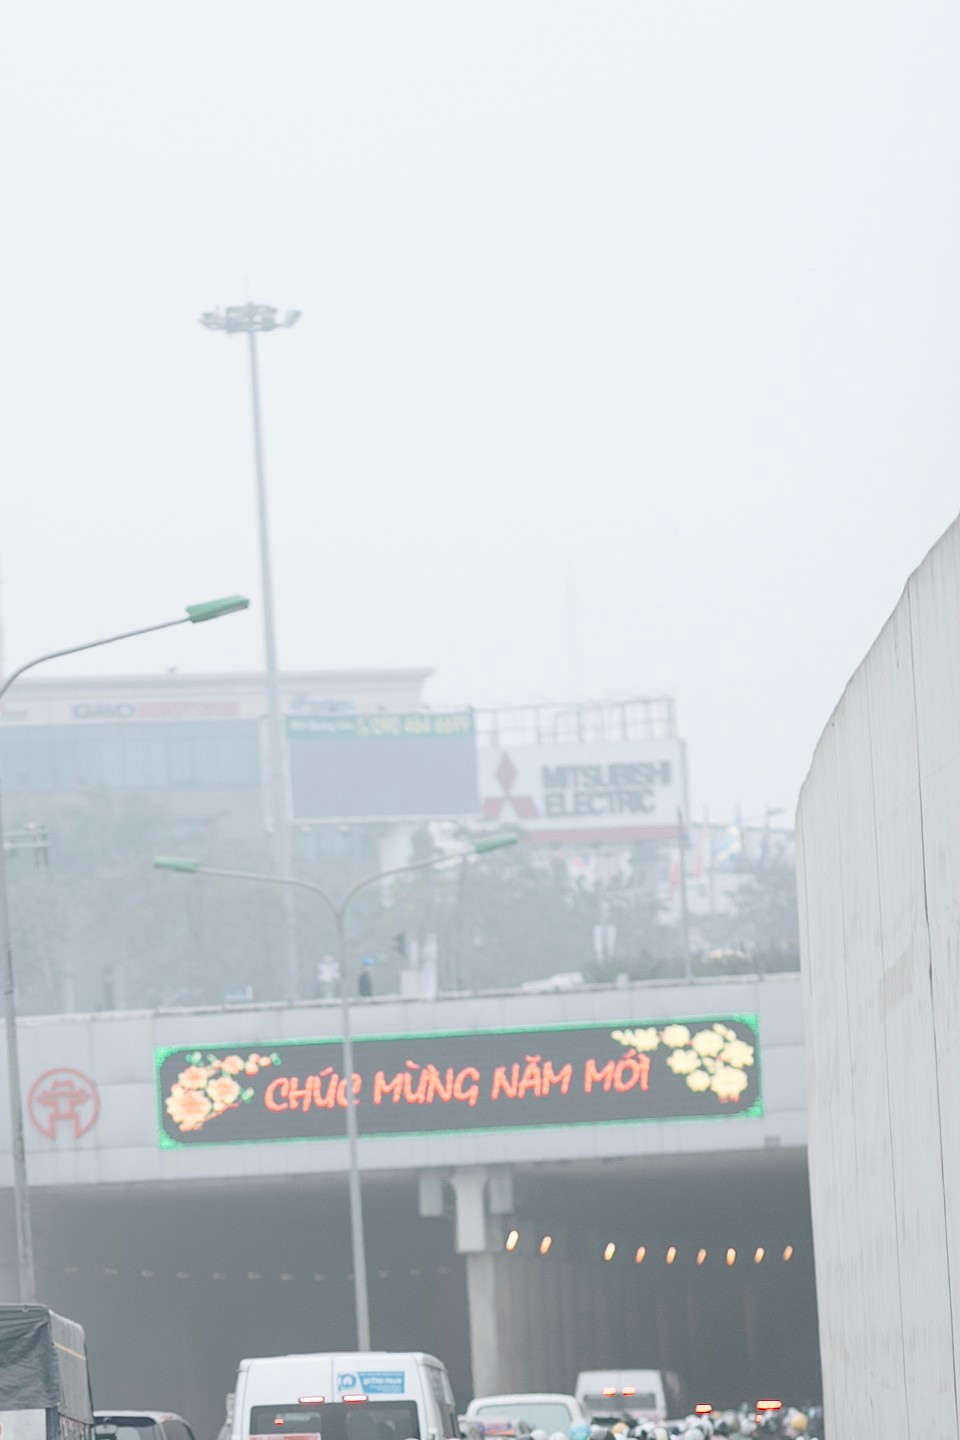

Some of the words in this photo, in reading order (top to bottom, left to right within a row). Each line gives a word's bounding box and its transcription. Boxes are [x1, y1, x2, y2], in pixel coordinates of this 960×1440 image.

[541, 760, 672, 789] MITSUBISHI
[545, 788, 656, 817] ELECTRIC
[263, 1066, 362, 1112] CHÚC
[373, 1059, 480, 1107] MỪNG
[491, 1054, 572, 1100] NĂM
